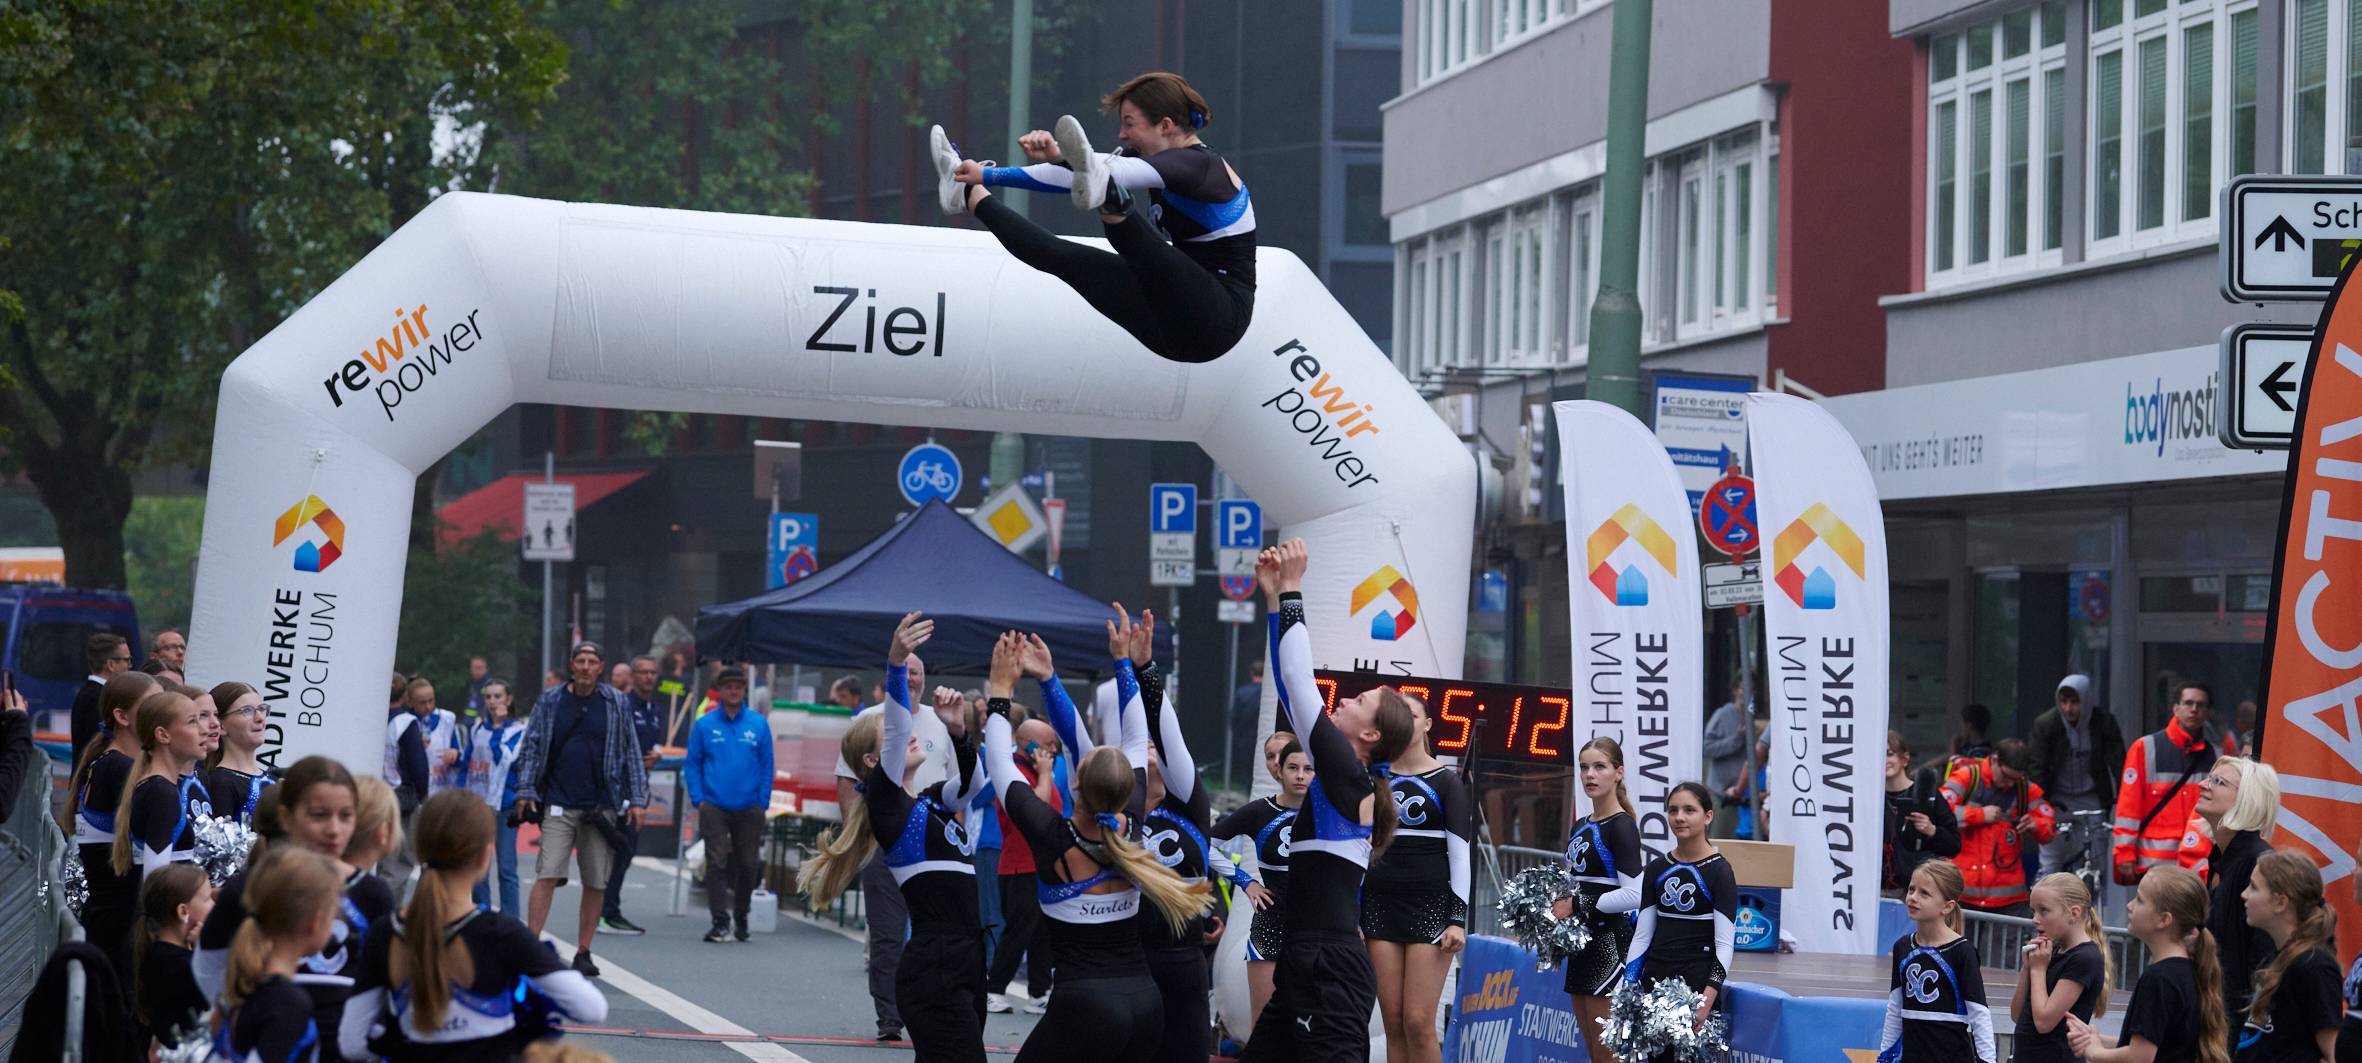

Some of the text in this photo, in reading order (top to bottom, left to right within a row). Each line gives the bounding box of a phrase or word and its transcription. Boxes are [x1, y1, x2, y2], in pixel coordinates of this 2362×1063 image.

[805, 285, 946, 357] Ziel
[323, 303, 430, 408] rewir
[375, 308, 482, 422] power
[1273, 338, 1380, 438] rewir
[1668, 396, 1745, 409] care center
[1261, 387, 1379, 488] power
[1943, 434, 1984, 467] WEITER
[1161, 491, 1185, 530] P
[1228, 506, 1252, 545] P
[779, 518, 800, 552] P
[297, 592, 338, 727] BOCHUM
[1079, 899, 1134, 917] Starlets
[1660, 876, 1696, 912] SC
[1905, 963, 1940, 1004] SC
[1517, 1002, 1580, 1049] STADTWERKE
